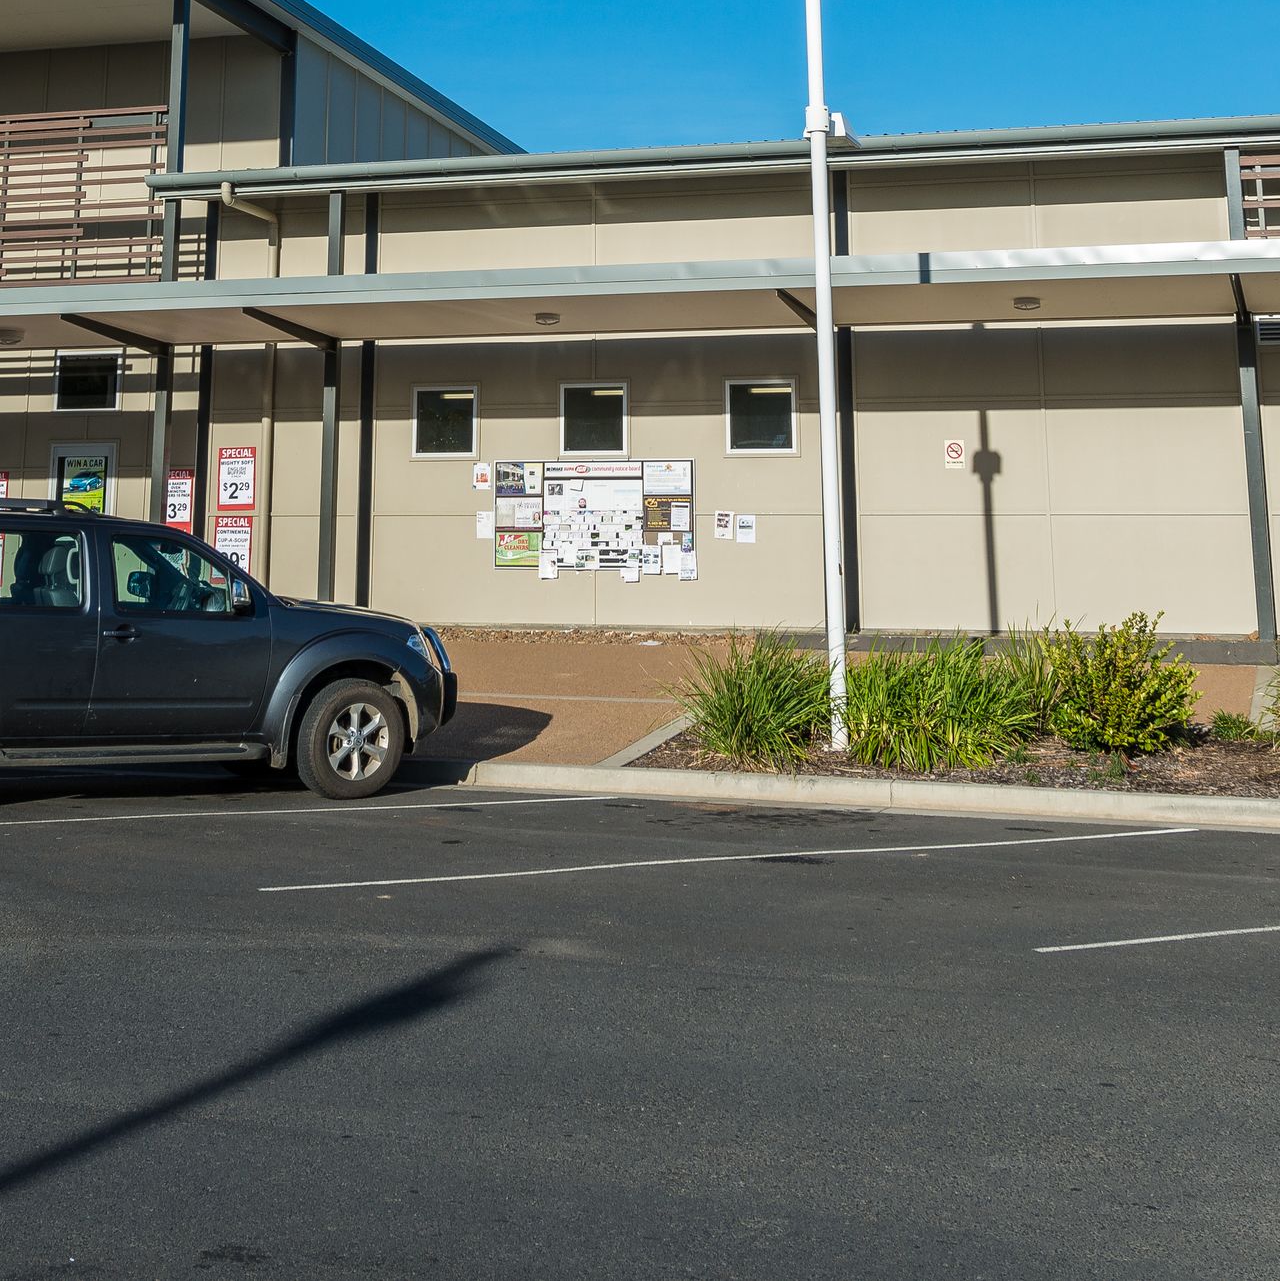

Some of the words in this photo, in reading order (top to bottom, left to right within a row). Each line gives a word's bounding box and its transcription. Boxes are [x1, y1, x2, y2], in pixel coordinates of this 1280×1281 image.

[221, 448, 253, 458] SPECIAL
[67, 459, 81, 468] WIN
[83, 460, 88, 468] A
[90, 459, 103, 468] CAR
[218, 517, 250, 527] SPECIAL
[500, 534, 515, 545] Jet
